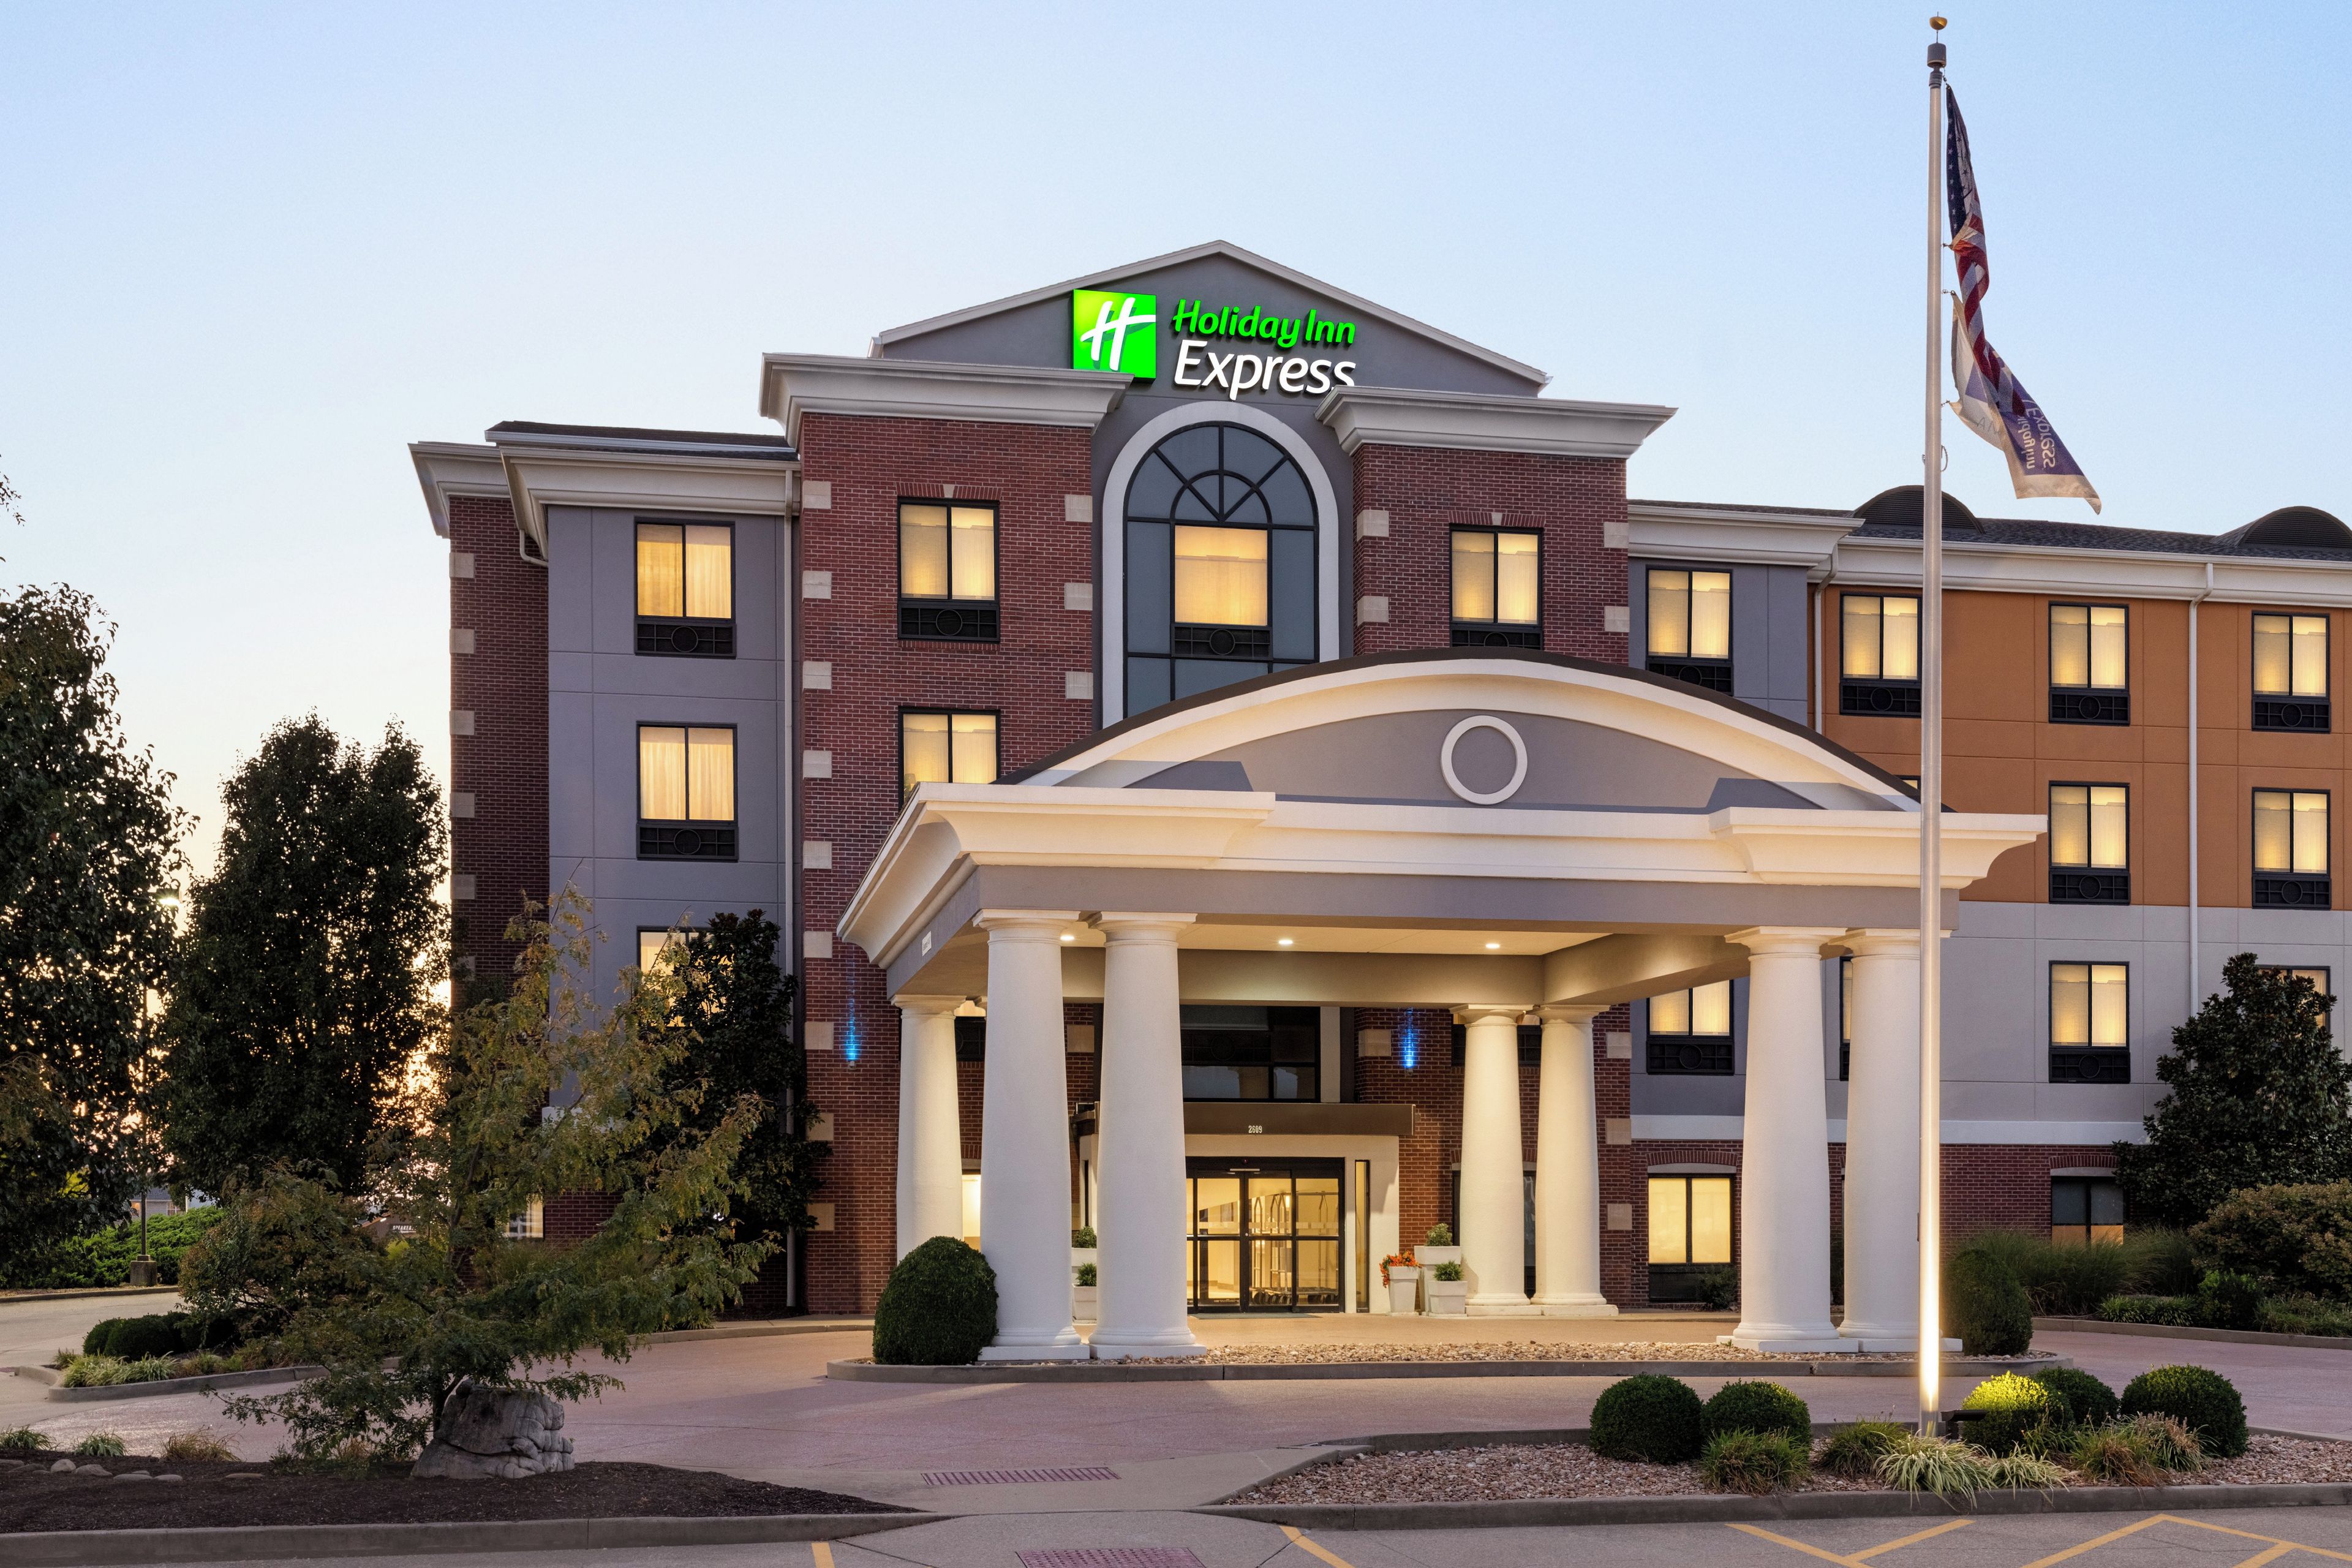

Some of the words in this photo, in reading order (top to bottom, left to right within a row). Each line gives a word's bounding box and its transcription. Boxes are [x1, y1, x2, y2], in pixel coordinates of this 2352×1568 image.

[1172, 299, 1300, 348] Holiday
[1305, 308, 1355, 344] Inn
[1174, 339, 1356, 401] Express
